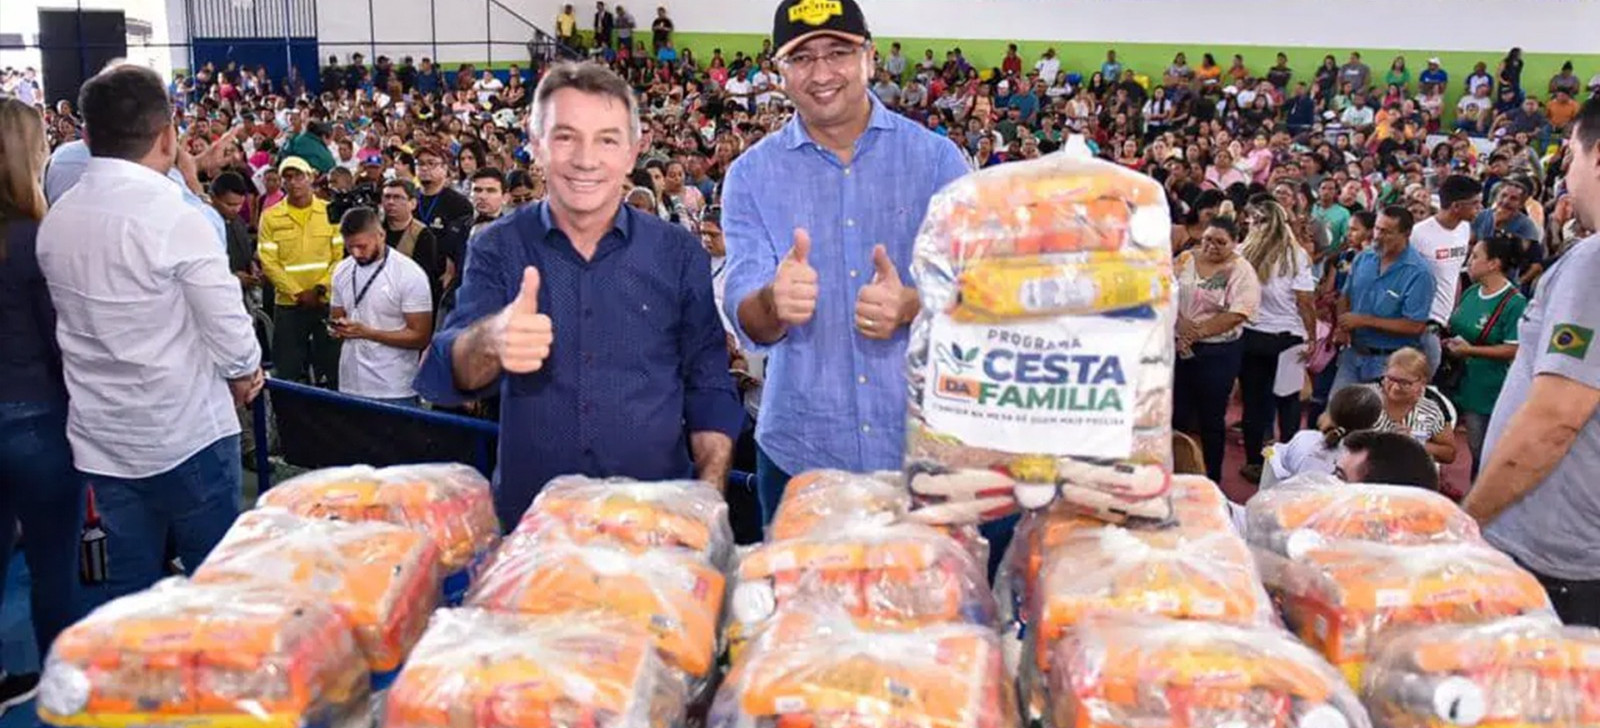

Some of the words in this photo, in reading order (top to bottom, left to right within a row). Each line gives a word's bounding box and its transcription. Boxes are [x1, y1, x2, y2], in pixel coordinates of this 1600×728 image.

[988, 328, 1082, 349] PROGRAMA
[983, 349, 1126, 385] CESTA
[945, 380, 970, 395] DA
[978, 382, 1123, 411] FAMILIA
